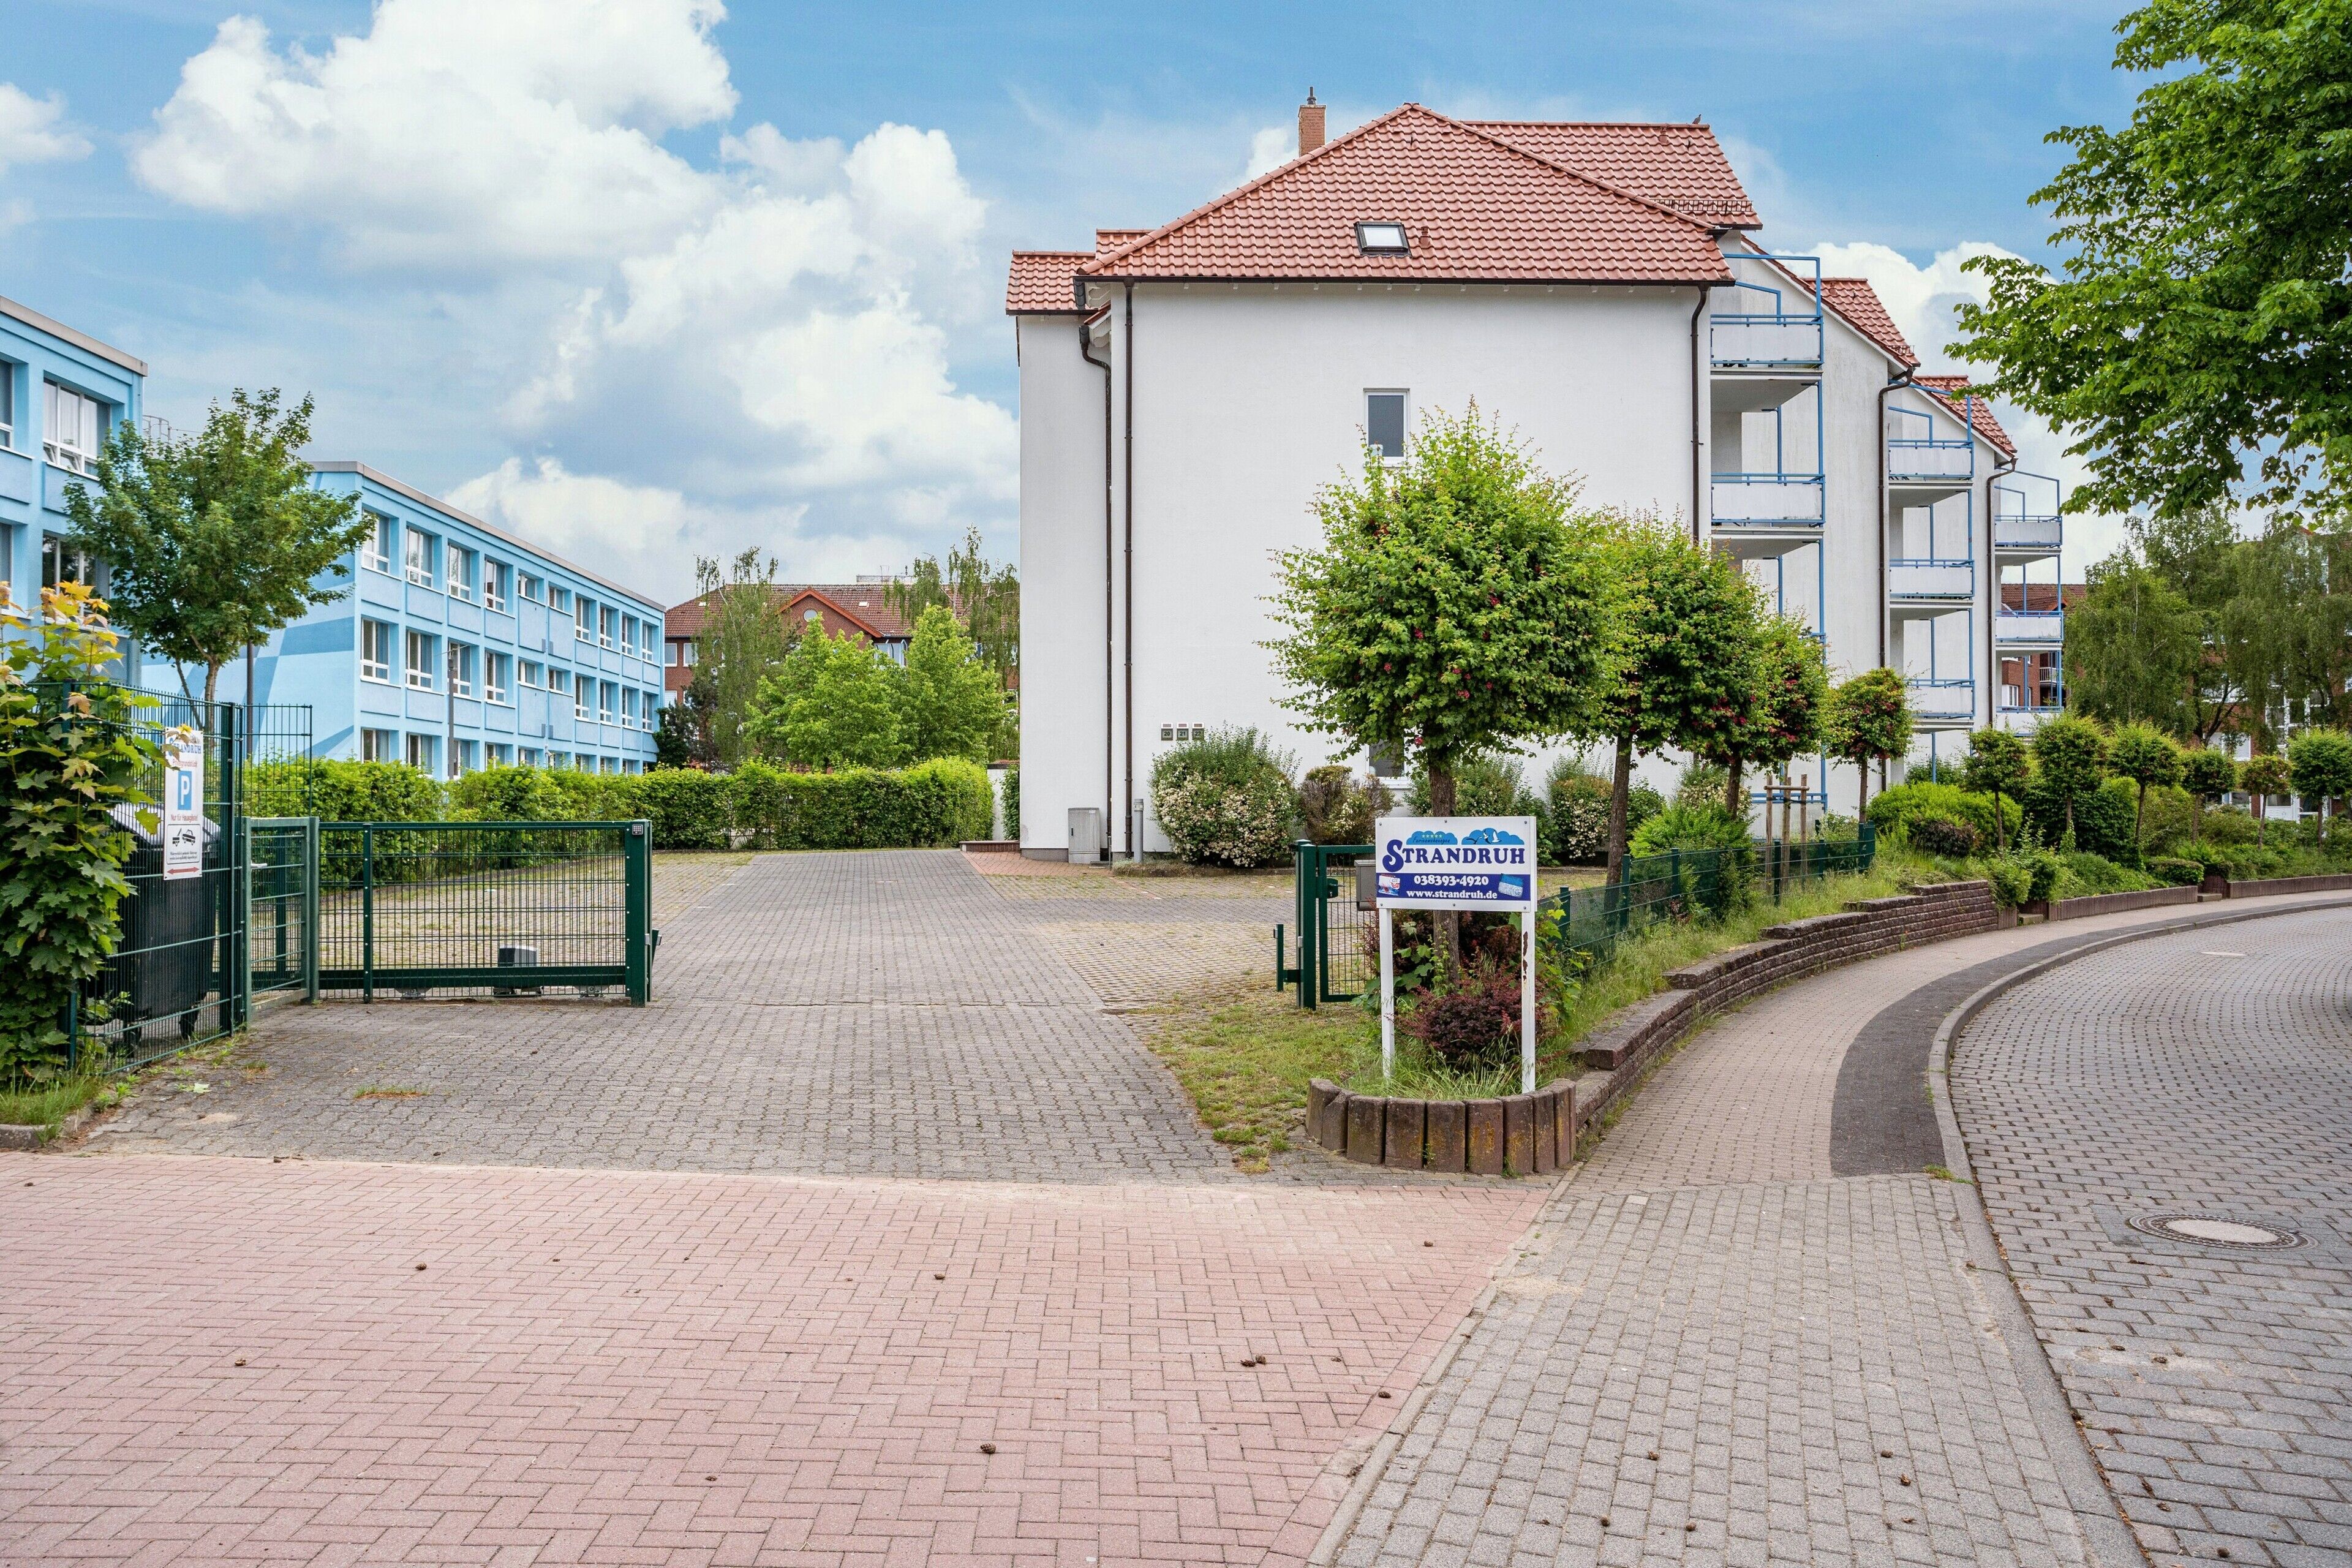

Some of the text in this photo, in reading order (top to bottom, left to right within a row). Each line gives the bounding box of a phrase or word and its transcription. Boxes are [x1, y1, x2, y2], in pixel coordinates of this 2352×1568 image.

[181, 775, 190, 805] P
[1382, 839, 1525, 872] STRANDRUH
[1414, 875, 1489, 886] 038393-4920
[1406, 889, 1498, 899] www.strandruh.de
